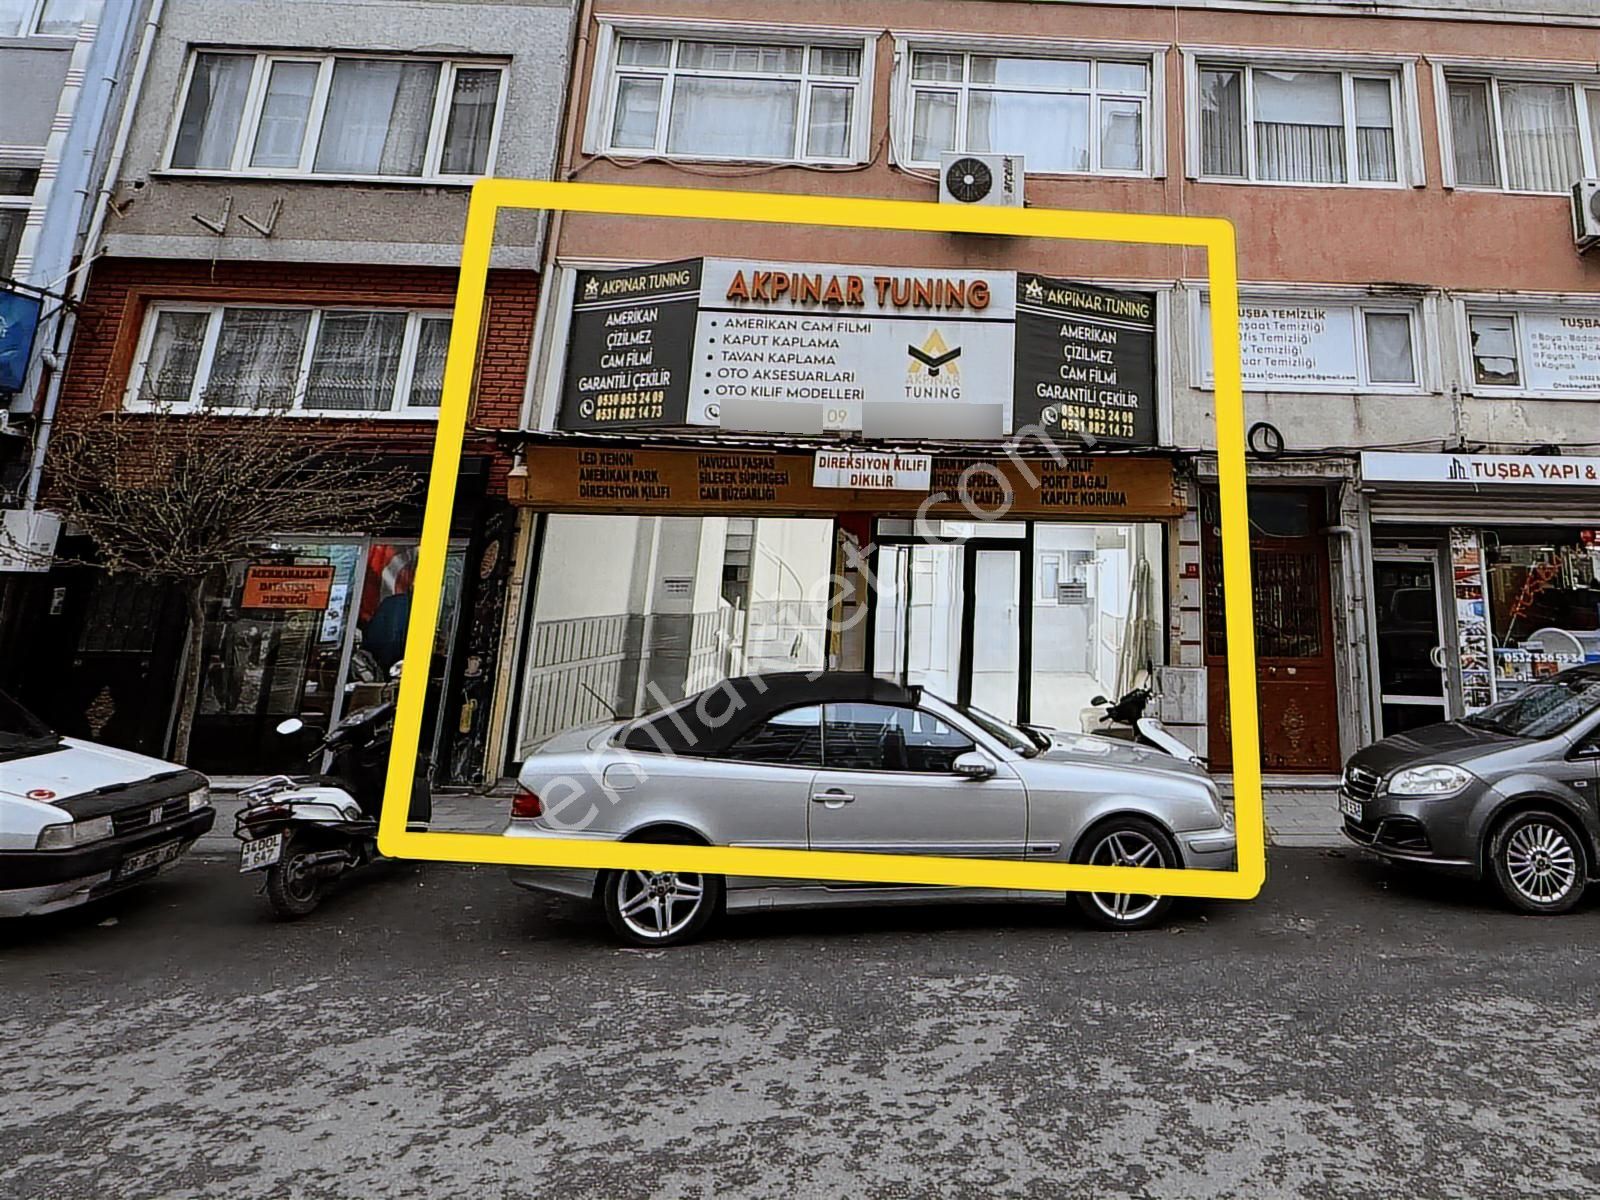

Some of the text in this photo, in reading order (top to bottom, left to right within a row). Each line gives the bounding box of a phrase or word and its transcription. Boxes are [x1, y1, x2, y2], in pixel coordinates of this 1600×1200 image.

[601, 270, 690, 295] AKPINAR TUNING
[727, 270, 990, 309] AKPINAR TUNING
[1047, 290, 1102, 312] AKPINAR
[1105, 298, 1149, 318] TUNING
[605, 307, 658, 327] AMERİKAN
[1238, 308, 1326, 320] UŞBA TEMİZLİK
[724, 316, 797, 331] AMERİKAN
[801, 321, 833, 333] CAM
[1238, 321, 1325, 333] nşaat Temizliği
[606, 329, 652, 350] ÇİZİLMEZ
[723, 334, 840, 348] KAPUT KAPLAMA
[1060, 324, 1117, 344] AMERİKAN
[1261, 333, 1312, 345] Temizliği
[1064, 342, 1113, 365] ÇİZİLMEZ
[1251, 344, 1303, 356] Temizliği
[600, 347, 653, 370] CAM FİLMİ
[721, 351, 836, 365] TAVAN KAPLAMA
[1266, 357, 1316, 369] Temizliği
[578, 368, 671, 391] GARANTİLİ ÇEKİLİR
[717, 367, 855, 382] OTO AKSESUARLARI
[1060, 365, 1117, 385] CAM FİLMİ
[597, 393, 619, 406] 0530
[639, 391, 650, 404] 24
[715, 384, 865, 400] OTO KILIF MODELLERİ
[904, 386, 961, 399] TUNING
[1036, 383, 1138, 408] GARANTİLİ ÇEKİLİR
[595, 407, 617, 420] 0531
[638, 405, 649, 418] 14
[651, 405, 662, 418] 73
[1061, 404, 1085, 418] 0530
[1108, 410, 1119, 422] 24
[1061, 418, 1085, 432] 0531
[1108, 422, 1119, 436] 14
[1122, 425, 1134, 437] 73
[578, 452, 597, 465] LED
[819, 454, 890, 471] DİREKSİYON
[894, 457, 927, 472] KILIFI
[633, 469, 659, 483] PARK
[1472, 462, 1598, 480] TUŞBA YAPI &
[1041, 475, 1108, 489] PORT BAGAJ
[700, 486, 720, 500] CAM
[1040, 491, 1127, 506] KAPUT KORUMA
[1504, 653, 1532, 663] 0532
